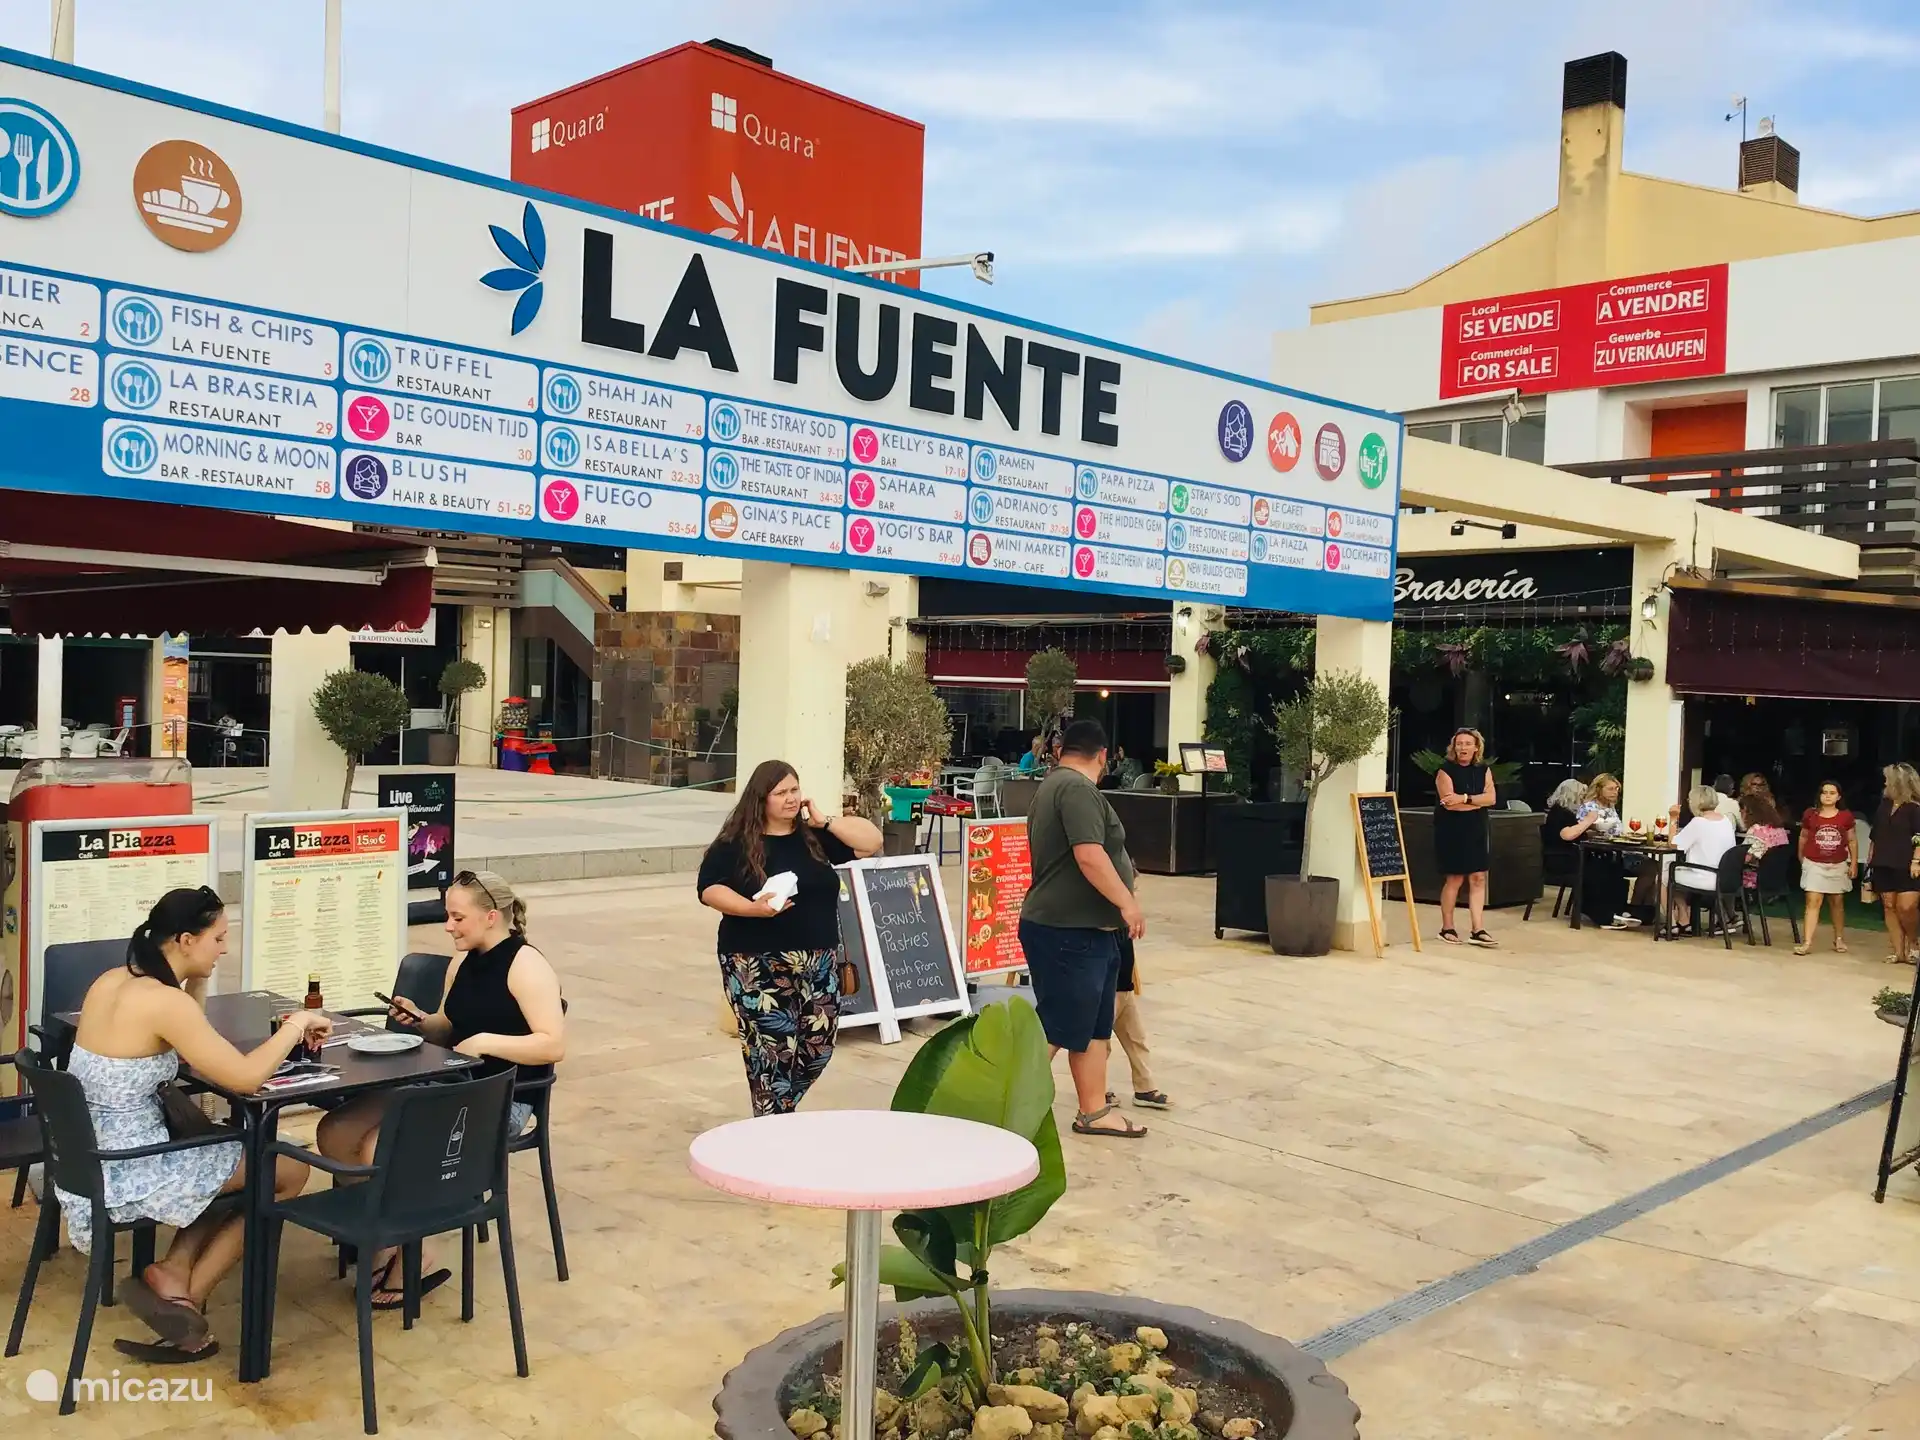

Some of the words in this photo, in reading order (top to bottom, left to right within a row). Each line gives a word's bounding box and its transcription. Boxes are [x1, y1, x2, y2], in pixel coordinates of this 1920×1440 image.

[743, 113, 814, 159] Quara
[1610, 280, 1672, 296] Commerce
[1472, 303, 1500, 316] Local
[1598, 304, 1613, 320] A
[1618, 288, 1704, 316] VENDRE
[80, 322, 90, 336] 2
[172, 305, 220, 330] FISH
[229, 315, 243, 334] &
[251, 320, 314, 346] CHIPS
[1463, 320, 1484, 338] SE
[1488, 310, 1554, 334] VENDE
[582, 227, 738, 372] LA
[773, 277, 1121, 447] FUENTE
[1608, 329, 1661, 344] Gewerbe
[172, 337, 194, 354] LA
[201, 342, 271, 365] FUENTE
[1470, 345, 1532, 361] Commercial
[1596, 350, 1616, 366] ZU
[1618, 338, 1704, 363] VERKAUFEN
[0, 344, 83, 375] ENCE
[395, 346, 492, 379] TRÜFFEL
[324, 363, 332, 376] 3
[1463, 362, 1500, 382] FOR
[1505, 356, 1552, 377] SALE
[70, 387, 90, 402] 28
[170, 370, 197, 391] LA
[209, 375, 318, 408] BRASERIA
[397, 375, 492, 401] RESTAURANT
[588, 380, 635, 402] SHAH
[642, 390, 672, 410] JAN
[528, 397, 534, 408] 4
[170, 401, 281, 428] RESTAURANT
[394, 402, 414, 422] DE
[421, 406, 492, 433] GOUDEN
[498, 418, 528, 438] TIJD
[588, 408, 667, 430] RESTAURANT
[316, 422, 333, 435] 29
[686, 424, 702, 436] 7-8
[744, 409, 767, 428] THE
[772, 413, 806, 434] STRAY
[810, 420, 836, 439] SOD
[396, 432, 422, 446] BAR
[742, 434, 759, 446] BAR
[882, 433, 934, 454] KELLY'S
[940, 444, 964, 460] BAR
[164, 433, 251, 461] MORNING
[258, 448, 268, 463] &
[275, 446, 329, 470] MOON
[518, 450, 532, 462] 30
[586, 434, 688, 464] ISABELLA'S
[586, 459, 663, 480] RESTAURANT
[882, 456, 897, 467] BAR
[999, 454, 1034, 471] RAMEN
[160, 464, 189, 480] BAR
[392, 460, 467, 484] BLUSH
[672, 470, 700, 485] 32-33
[741, 457, 760, 473] THE
[764, 460, 792, 478] TASTE
[796, 466, 810, 480] OF
[814, 469, 843, 485] INDIA
[945, 466, 966, 478] 17-18
[316, 481, 330, 494] 58
[742, 480, 808, 500] RESTAURANT
[880, 476, 936, 498] SAHARA
[998, 475, 1048, 492] RESTAURANT
[1102, 473, 1124, 487] PAPA
[1128, 477, 1154, 492] PIZZA
[393, 489, 424, 504] HAIR
[430, 493, 438, 506] &
[443, 495, 490, 511] BEAUTY
[584, 484, 652, 508] FUEGO
[820, 492, 842, 504] 34-35
[1100, 492, 1136, 505] TAKEAWAY
[1191, 488, 1222, 504] STRAY'S
[1224, 494, 1240, 506] SOD
[498, 501, 532, 516] 51-52
[879, 501, 894, 511] BAR
[996, 498, 1058, 517] ADRIANO'S
[1190, 506, 1208, 516] GOLF
[586, 514, 606, 526] BAR
[742, 506, 788, 524] GINA'S
[792, 512, 831, 529] PLACE
[954, 510, 962, 520] 36
[1100, 512, 1112, 526] THE
[1116, 514, 1144, 530] HIDDEN
[1146, 519, 1162, 532] GEM
[1345, 514, 1354, 524] TU
[668, 522, 697, 535] 53-54
[996, 516, 1046, 532] RESTAURANT
[742, 530, 766, 543] CAFE
[770, 534, 804, 547] BAKERY
[878, 522, 924, 541] YOGI'S
[930, 528, 953, 544] BAR
[1098, 532, 1110, 541] BAR
[1190, 525, 1202, 536] THE
[1204, 528, 1228, 540] STONE
[1229, 531, 1248, 544] GRILL
[830, 542, 840, 551] 46
[876, 546, 892, 556] BAR
[996, 538, 1020, 551] MINI
[1024, 542, 1066, 558] MARKET
[1188, 543, 1228, 556] RESTAURANT
[1270, 536, 1278, 548] LA
[1281, 538, 1308, 552] PIAZZA
[940, 553, 960, 564] 59-60
[1097, 551, 1109, 564] THE
[1268, 554, 1304, 566] RESTAURANT
[1342, 548, 1388, 564] LOCKHART'S
[994, 559, 1016, 570] SHOP
[1024, 562, 1044, 572] CAFE
[1224, 566, 1246, 580] CENTER
[1096, 570, 1108, 578] BAR
[1202, 582, 1220, 592] ESTATE
[390, 790, 413, 804] Live
[79, 834, 104, 850] La
[112, 833, 176, 849] Piazza
[269, 836, 290, 850] La
[296, 833, 350, 848] Piazza
[914, 960, 940, 976] from
[917, 976, 944, 987] oven
